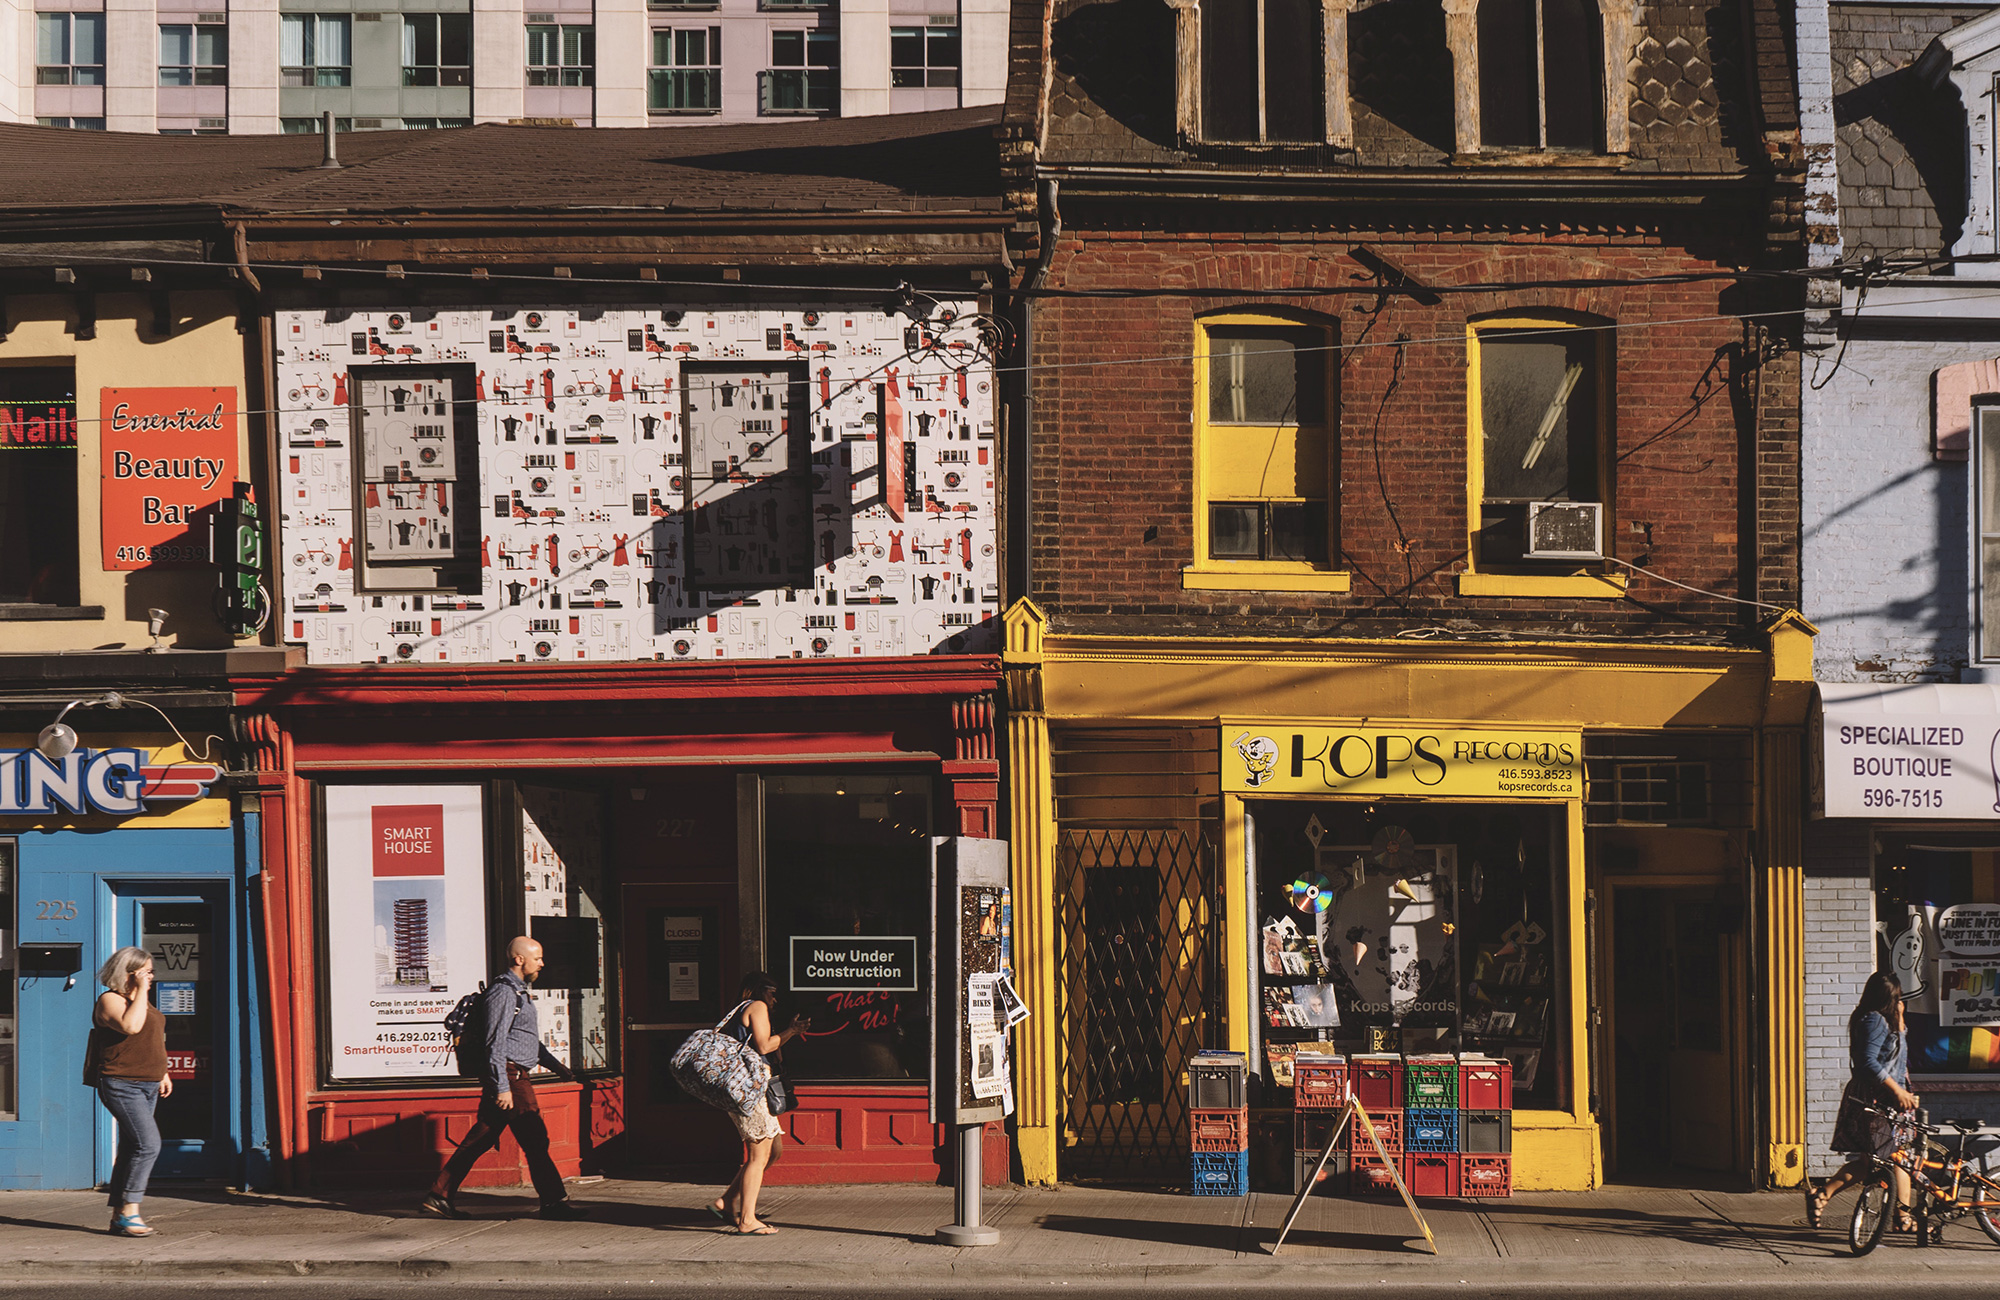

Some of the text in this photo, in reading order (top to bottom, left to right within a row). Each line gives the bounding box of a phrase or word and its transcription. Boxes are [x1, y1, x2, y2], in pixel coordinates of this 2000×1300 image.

[111, 402, 223, 431] Essential
[114, 450, 224, 490] Beauty
[142, 496, 196, 525] Bar
[1840, 725, 1965, 746] SPECIALIZED
[1290, 734, 1575, 788] KOPS RECORDS
[1853, 757, 1953, 778] BOUTIQUE
[1498, 767, 1573, 781] 416.593.8523
[1498, 780, 1573, 794] kopsrecords.ca
[1863, 788, 1943, 808] 596-7515
[383, 826, 433, 841] SMART
[656, 818, 697, 838] 227
[384, 840, 433, 855] HOUSE
[35, 900, 78, 921] 225
[1943, 917, 1974, 929] TUNE
[1974, 917, 1988, 929] IN
[666, 929, 701, 938] CLOSED
[1966, 929, 1985, 939] THE
[1954, 939, 1975, 947] WITH
[813, 949, 895, 963] Now Under
[806, 964, 902, 979] Construction
[403, 999, 418, 1007] and
[826, 982, 891, 1012] That's
[972, 999, 991, 1008] BIKES
[1350, 999, 1389, 1015] Kops
[859, 1004, 898, 1030] Us!
[376, 1032, 451, 1042] 416.292.0219
[183, 1056, 209, 1069] EAT
